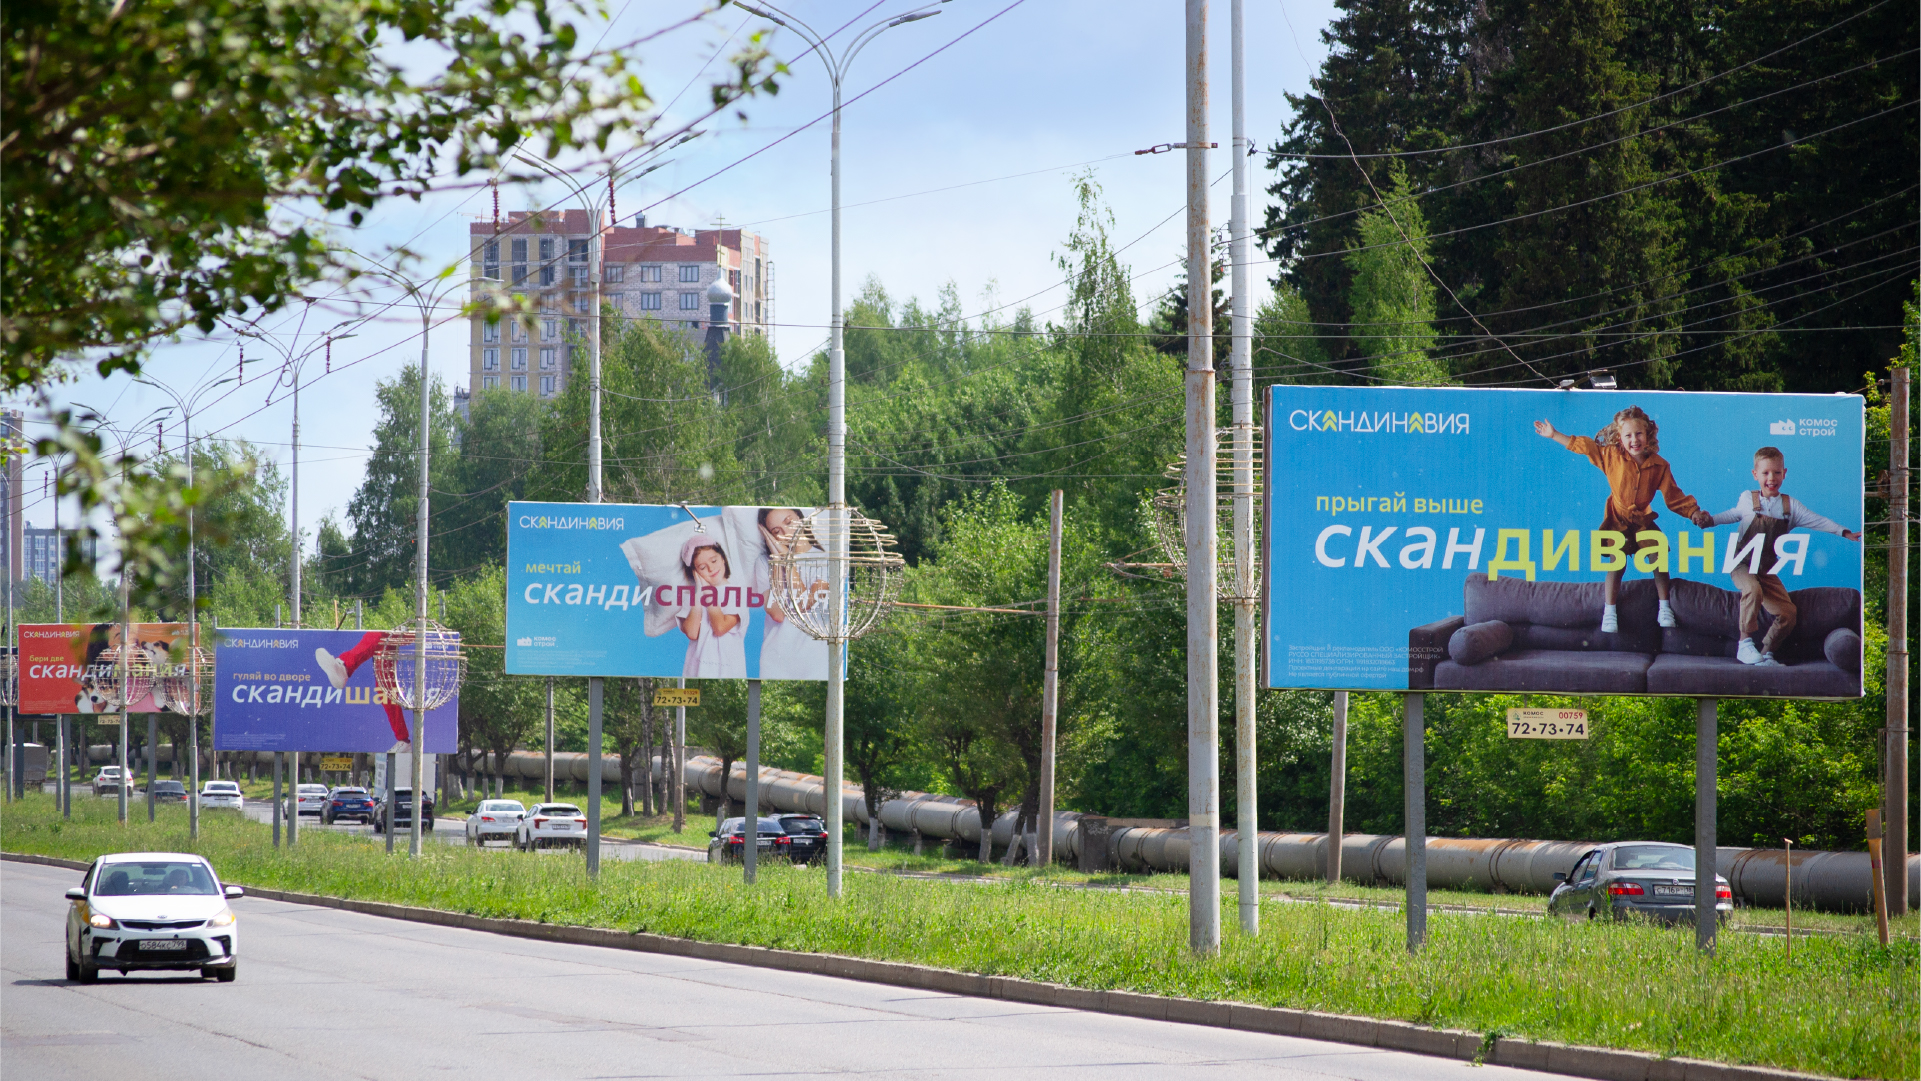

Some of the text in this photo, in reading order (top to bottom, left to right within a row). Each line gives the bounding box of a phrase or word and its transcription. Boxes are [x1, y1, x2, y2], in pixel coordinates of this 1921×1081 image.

[1289, 409, 1470, 435] СКАНДИНАВИЯ
[1799, 427, 1836, 437] строй
[1316, 492, 1484, 517] прыгай выше
[519, 515, 624, 531] СКАНДИНАВИЯ
[1314, 525, 1811, 582] скандивания
[525, 560, 581, 575] мечтай
[24, 630, 80, 639] СКАНДИНАВИЯ
[224, 638, 298, 649] СКАНДИНАВИЯ
[29, 655, 48, 664] бери
[233, 671, 311, 683] гуляй во дворе
[1558, 711, 1584, 719] 00759
